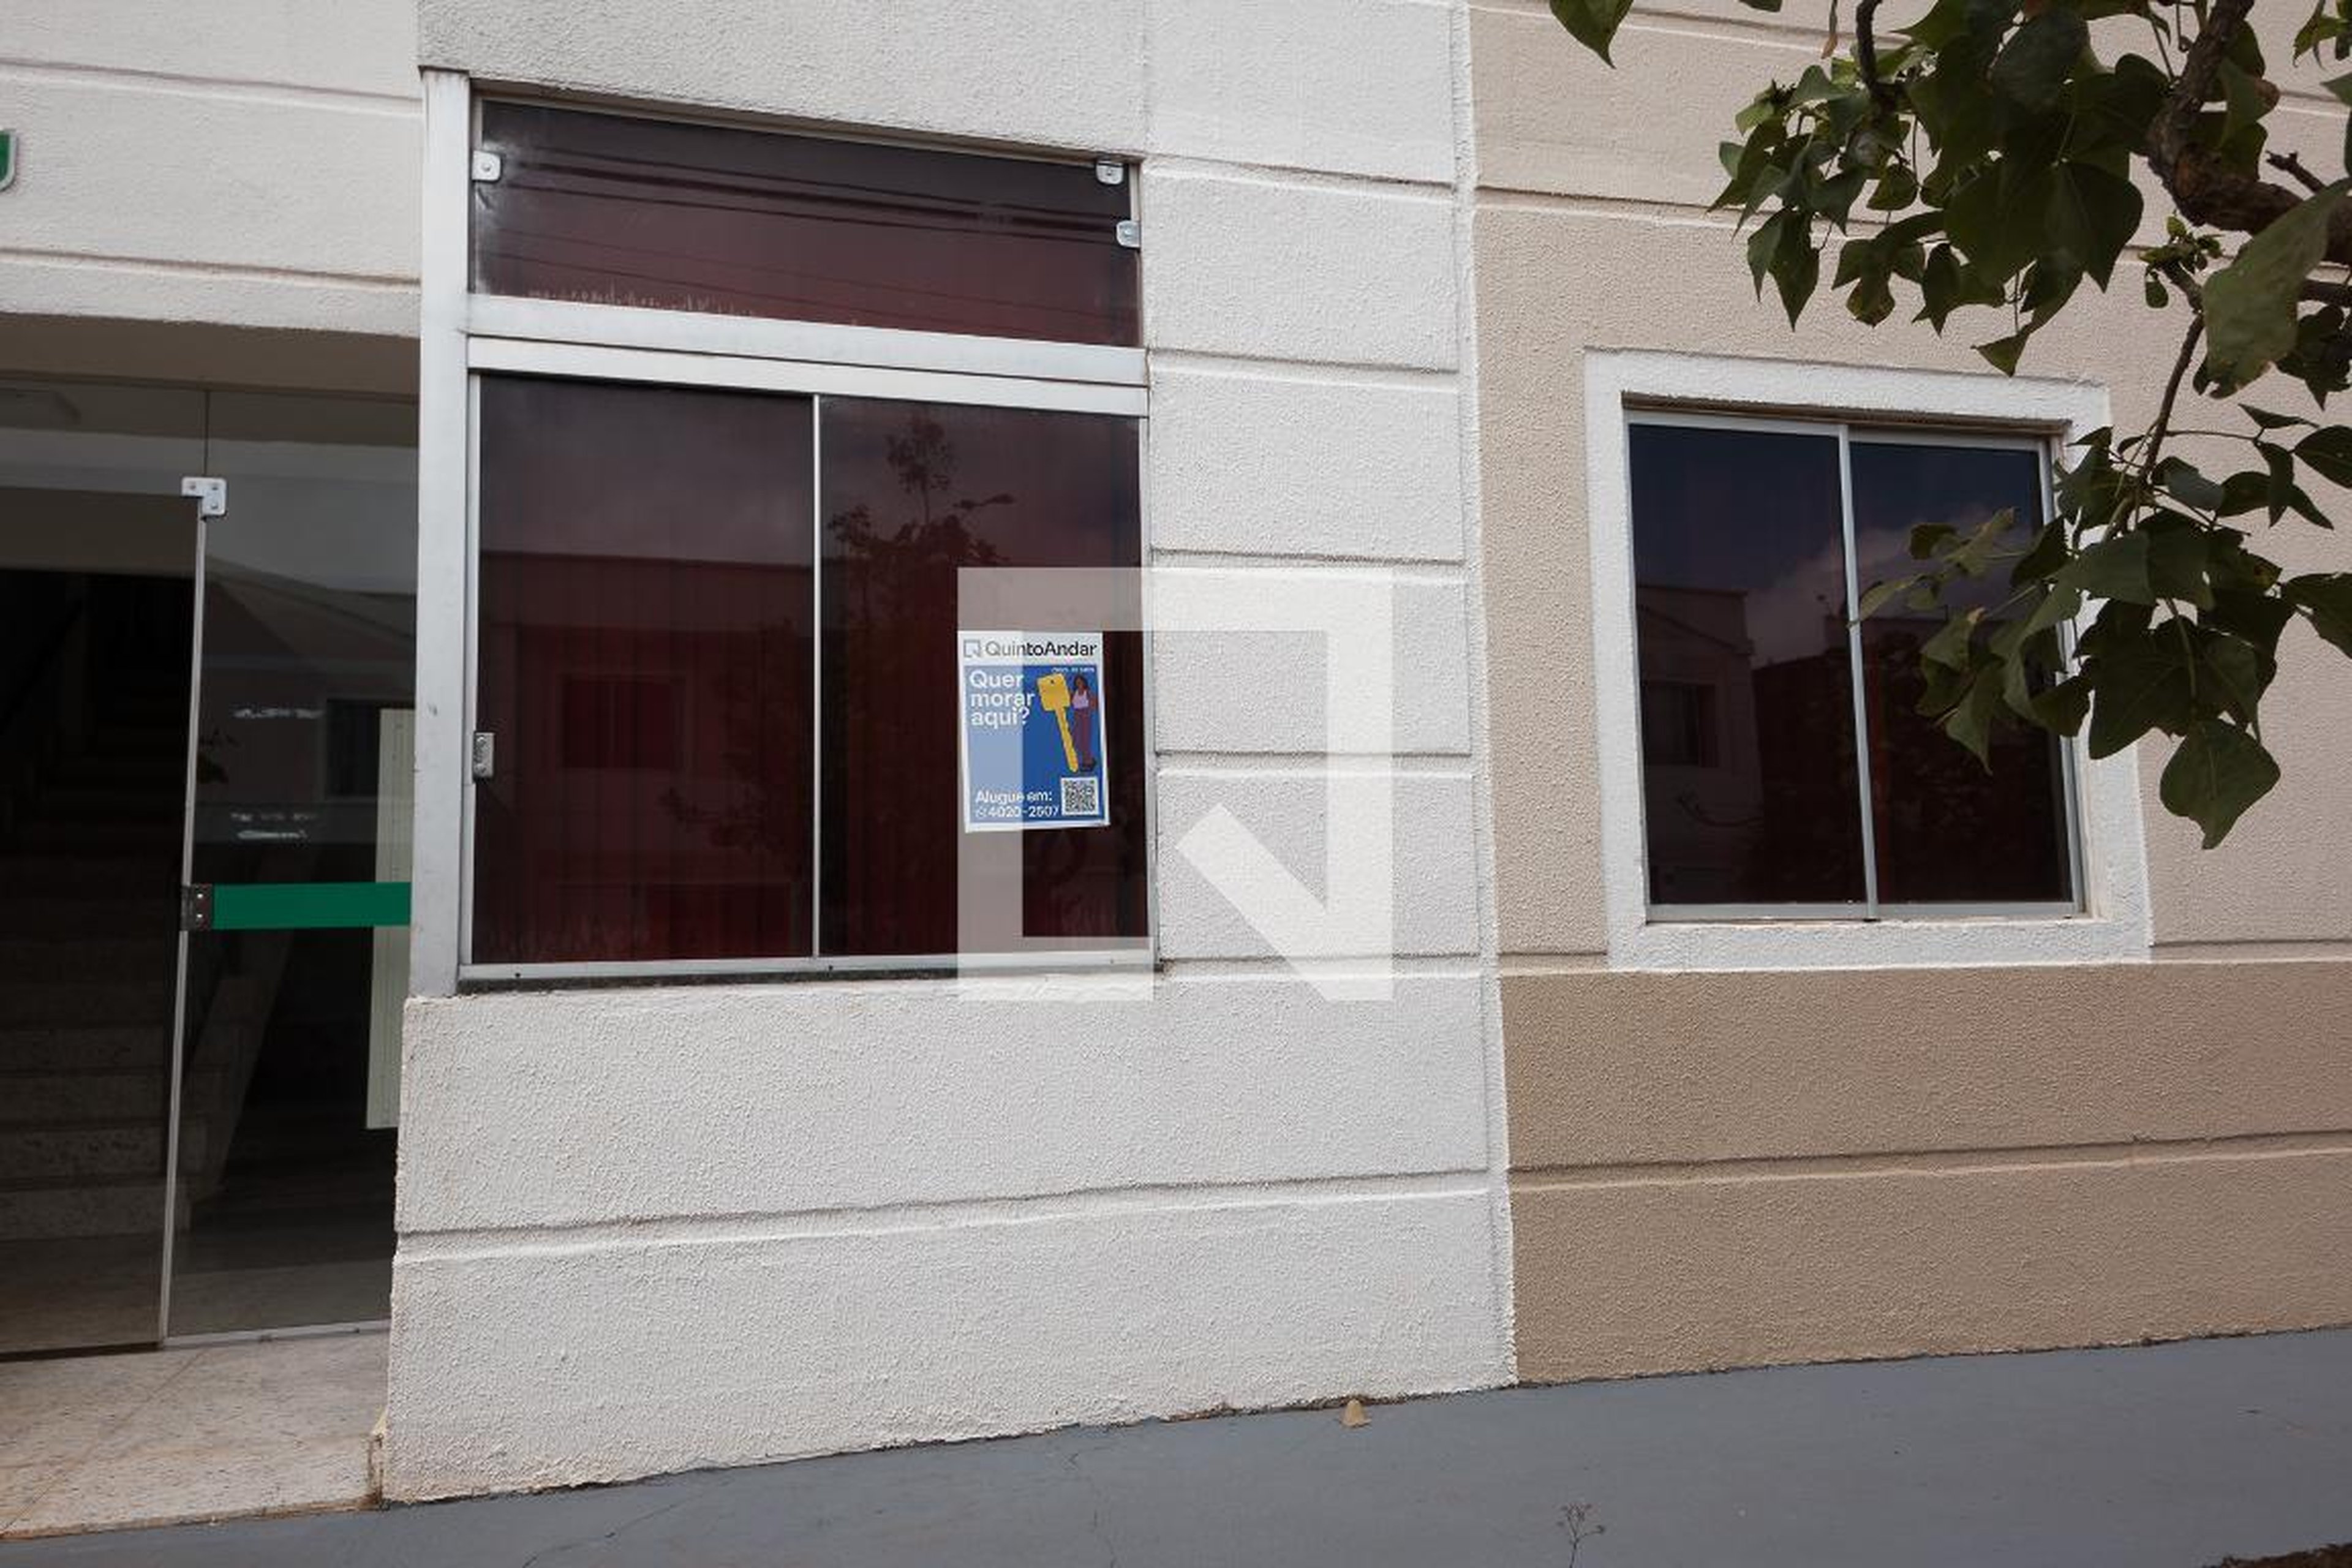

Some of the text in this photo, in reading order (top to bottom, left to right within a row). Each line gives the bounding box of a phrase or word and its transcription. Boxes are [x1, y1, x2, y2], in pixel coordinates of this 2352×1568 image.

[985, 640, 1097, 656] QuintoAndar
[969, 669, 1024, 688] Quer
[971, 693, 1036, 707] morar
[971, 707, 1030, 729] aqui?
[976, 790, 1053, 805] Alugue em:
